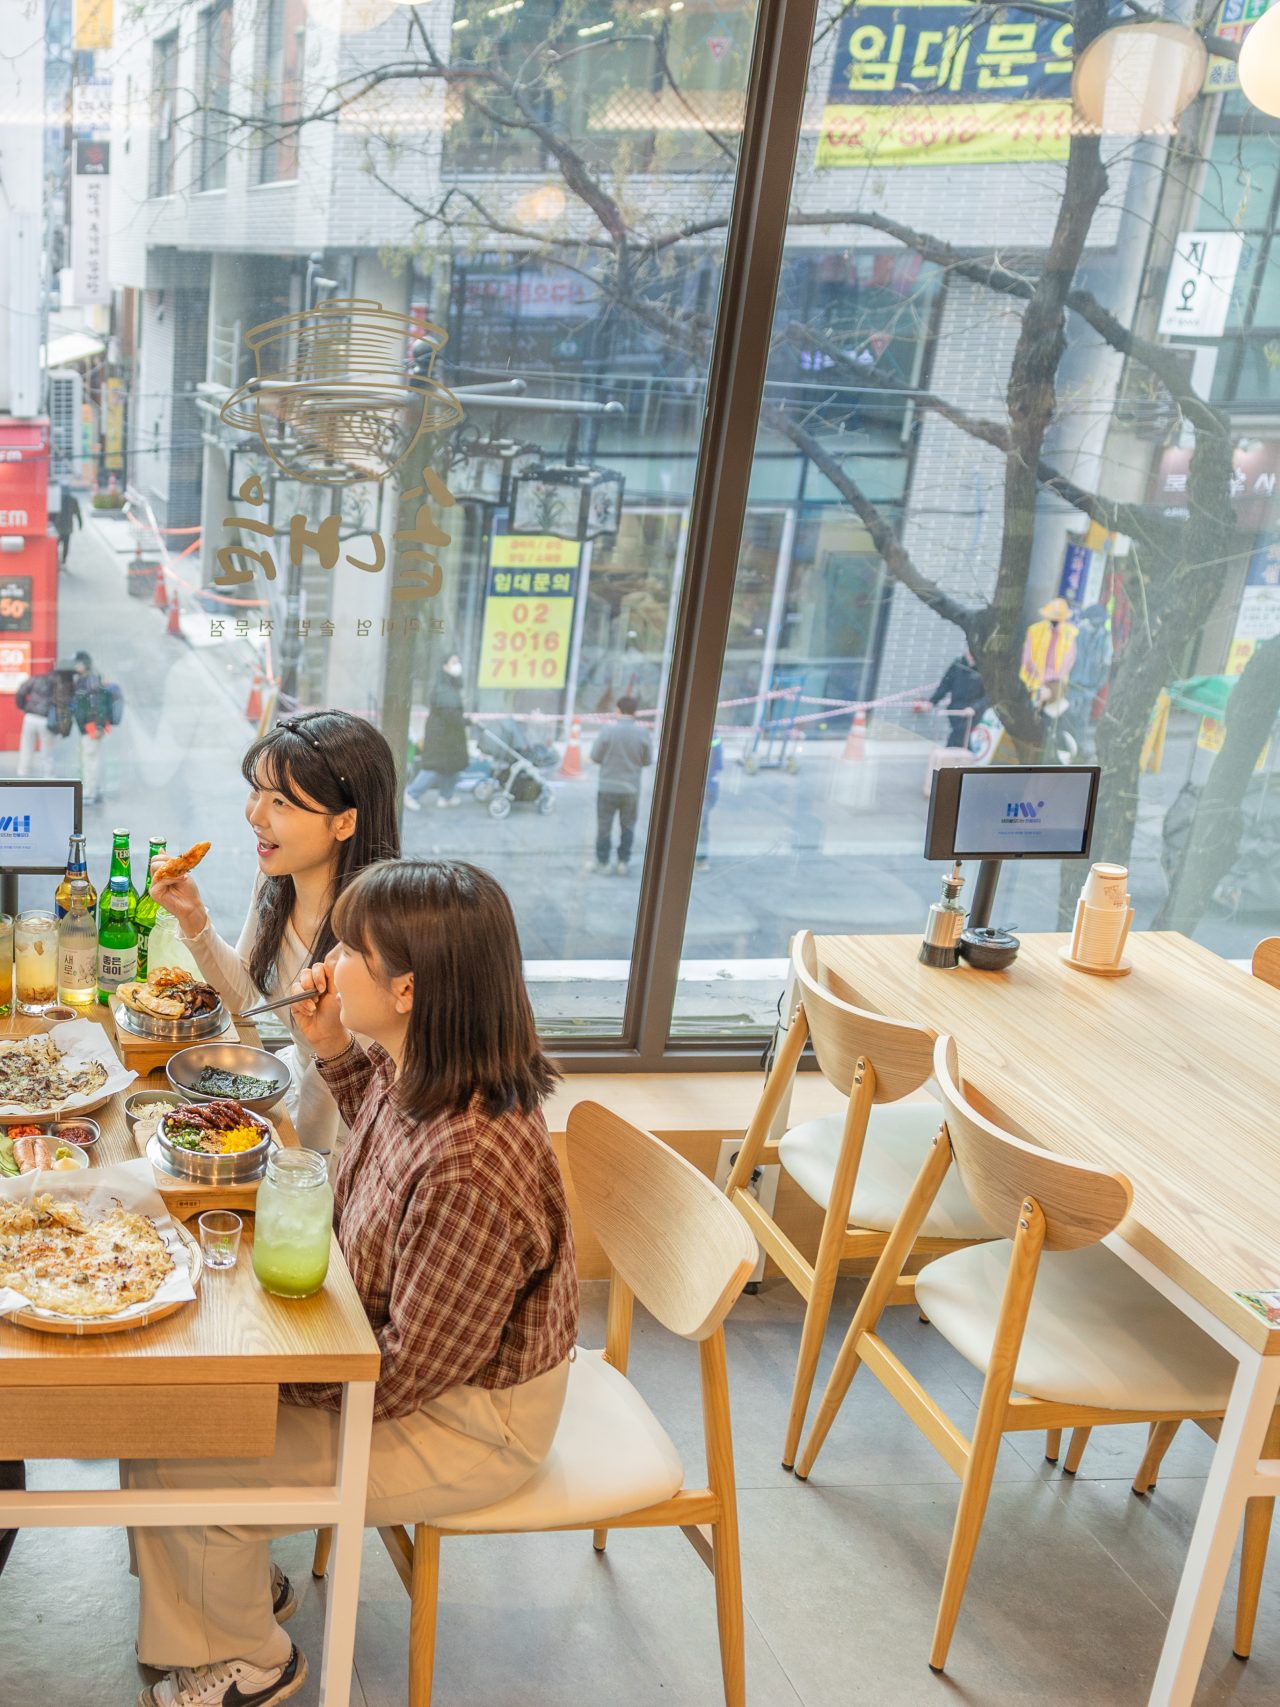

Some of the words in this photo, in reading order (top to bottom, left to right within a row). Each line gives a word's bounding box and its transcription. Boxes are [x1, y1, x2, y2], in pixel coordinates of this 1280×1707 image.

[494, 572, 570, 594] 임대문의
[512, 603, 549, 625] 02
[491, 631, 560, 652] 3016
[491, 658, 558, 679] 7110
[102, 965, 121, 975] 데이
[103, 955, 121, 966] 좋은
